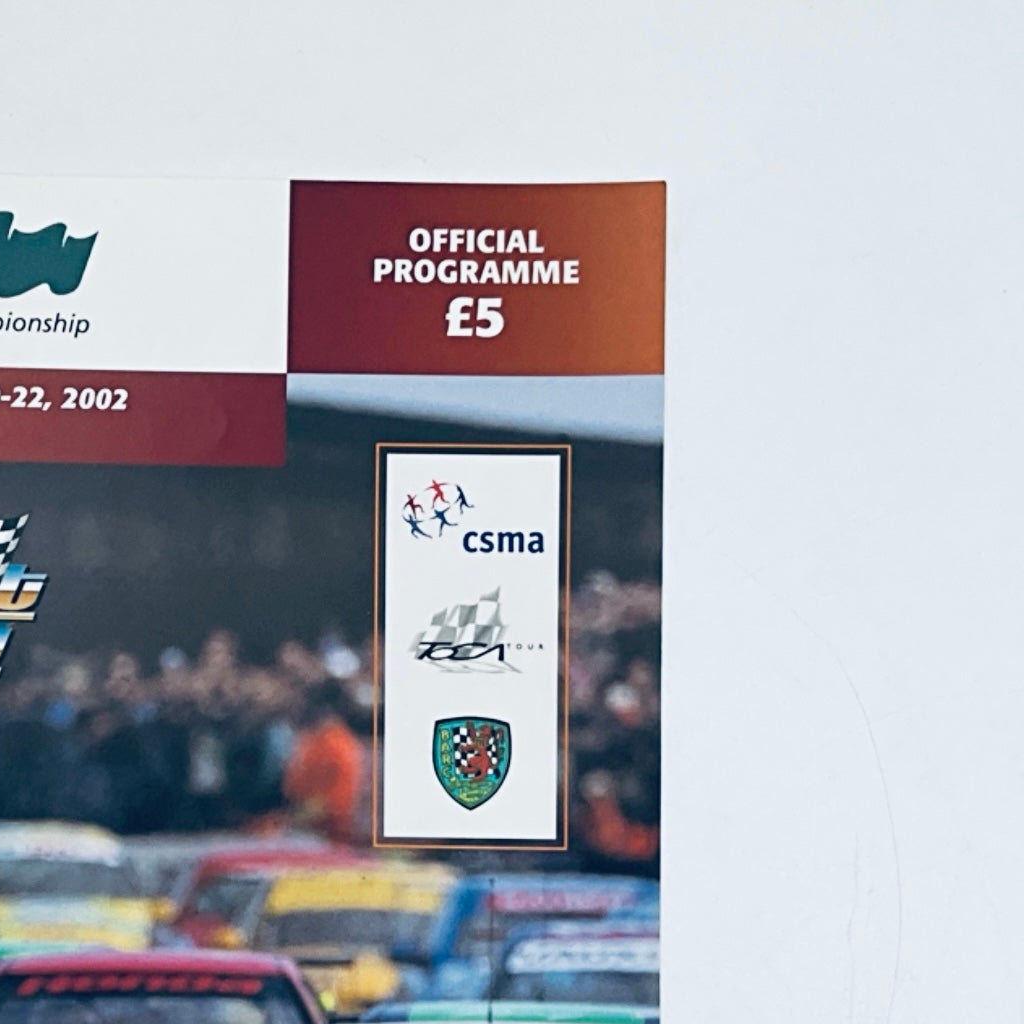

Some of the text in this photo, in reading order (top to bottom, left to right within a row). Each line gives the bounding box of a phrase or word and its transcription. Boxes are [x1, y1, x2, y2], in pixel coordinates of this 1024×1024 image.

[408, 228, 545, 254] OFFICIAL
[373, 258, 580, 285] PROGRAMME
[445, 296, 506, 338] £5
[60, 387, 129, 412] 2002
[463, 529, 546, 554] csma
[506, 643, 545, 651] TOUR
